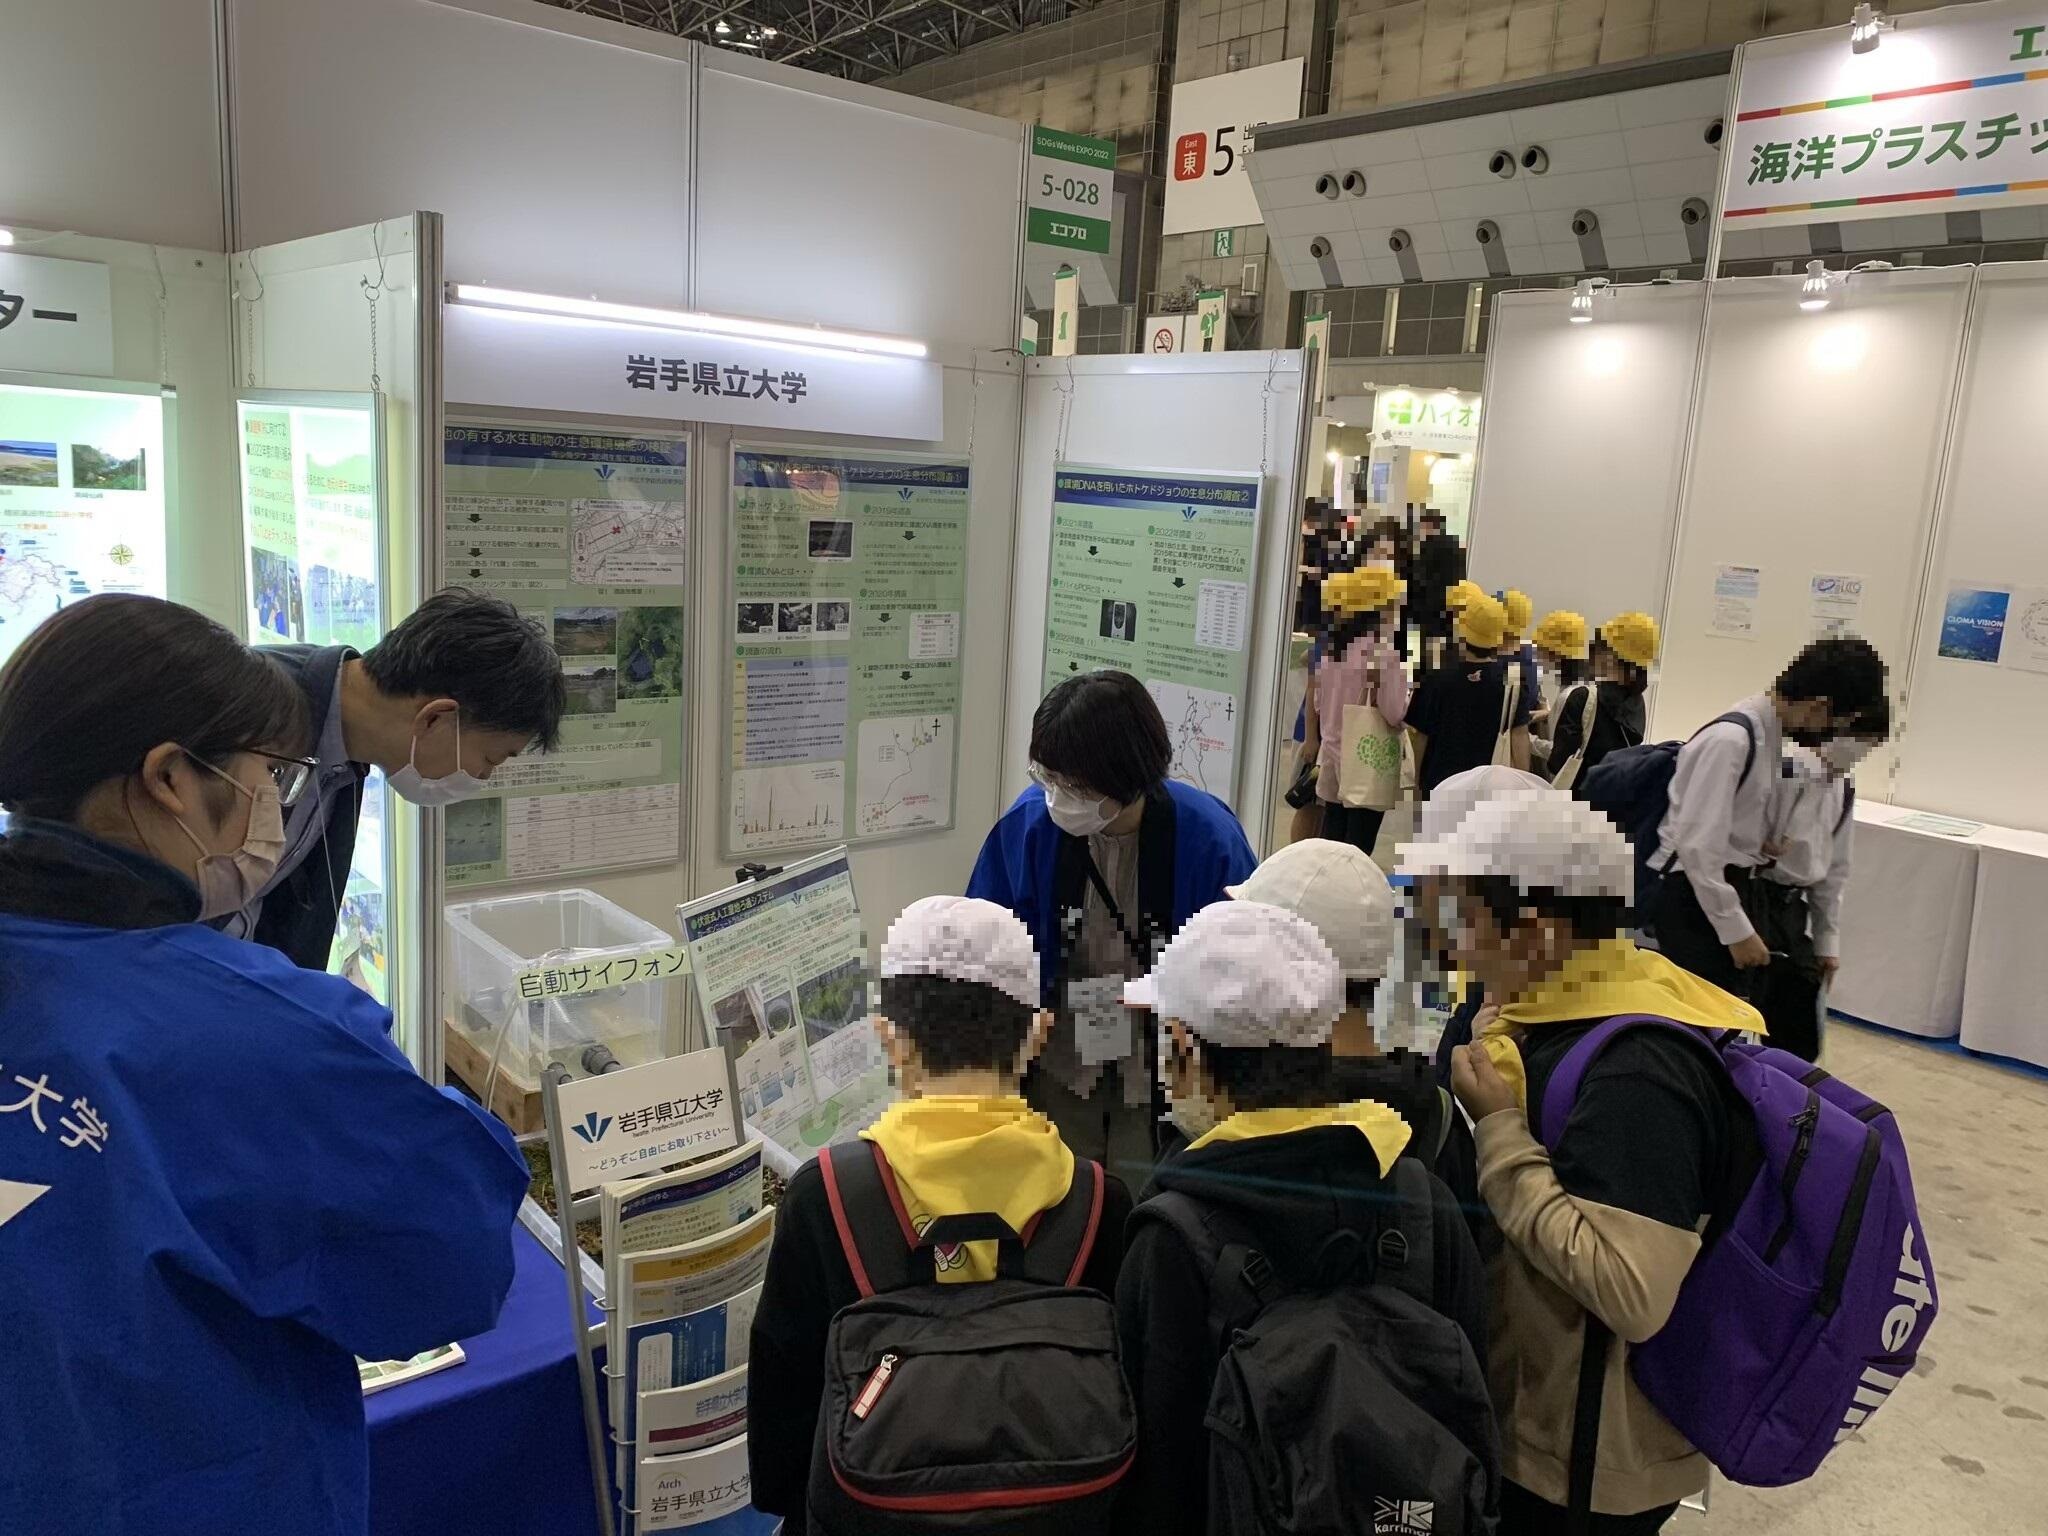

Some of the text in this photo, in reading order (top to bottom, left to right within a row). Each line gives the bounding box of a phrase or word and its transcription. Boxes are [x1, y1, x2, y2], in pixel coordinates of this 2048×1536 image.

[2010, 26, 2048, 61] エ
[1185, 140, 1197, 149] East
[1213, 126, 1235, 176] 5
[1183, 151, 1197, 175] 東
[1041, 174, 1099, 205] 5-028
[1050, 222, 1087, 241] エコプロ
[626, 354, 807, 404] 岩手県立大学
[519, 952, 686, 999] 自動サイフォン
[0, 1063, 109, 1154] 大学
[618, 1087, 724, 1133] 岩手県立大学
[651, 1119, 684, 1136] Prefectural
[685, 1111, 716, 1126] University
[657, 1479, 682, 1490] Arch
